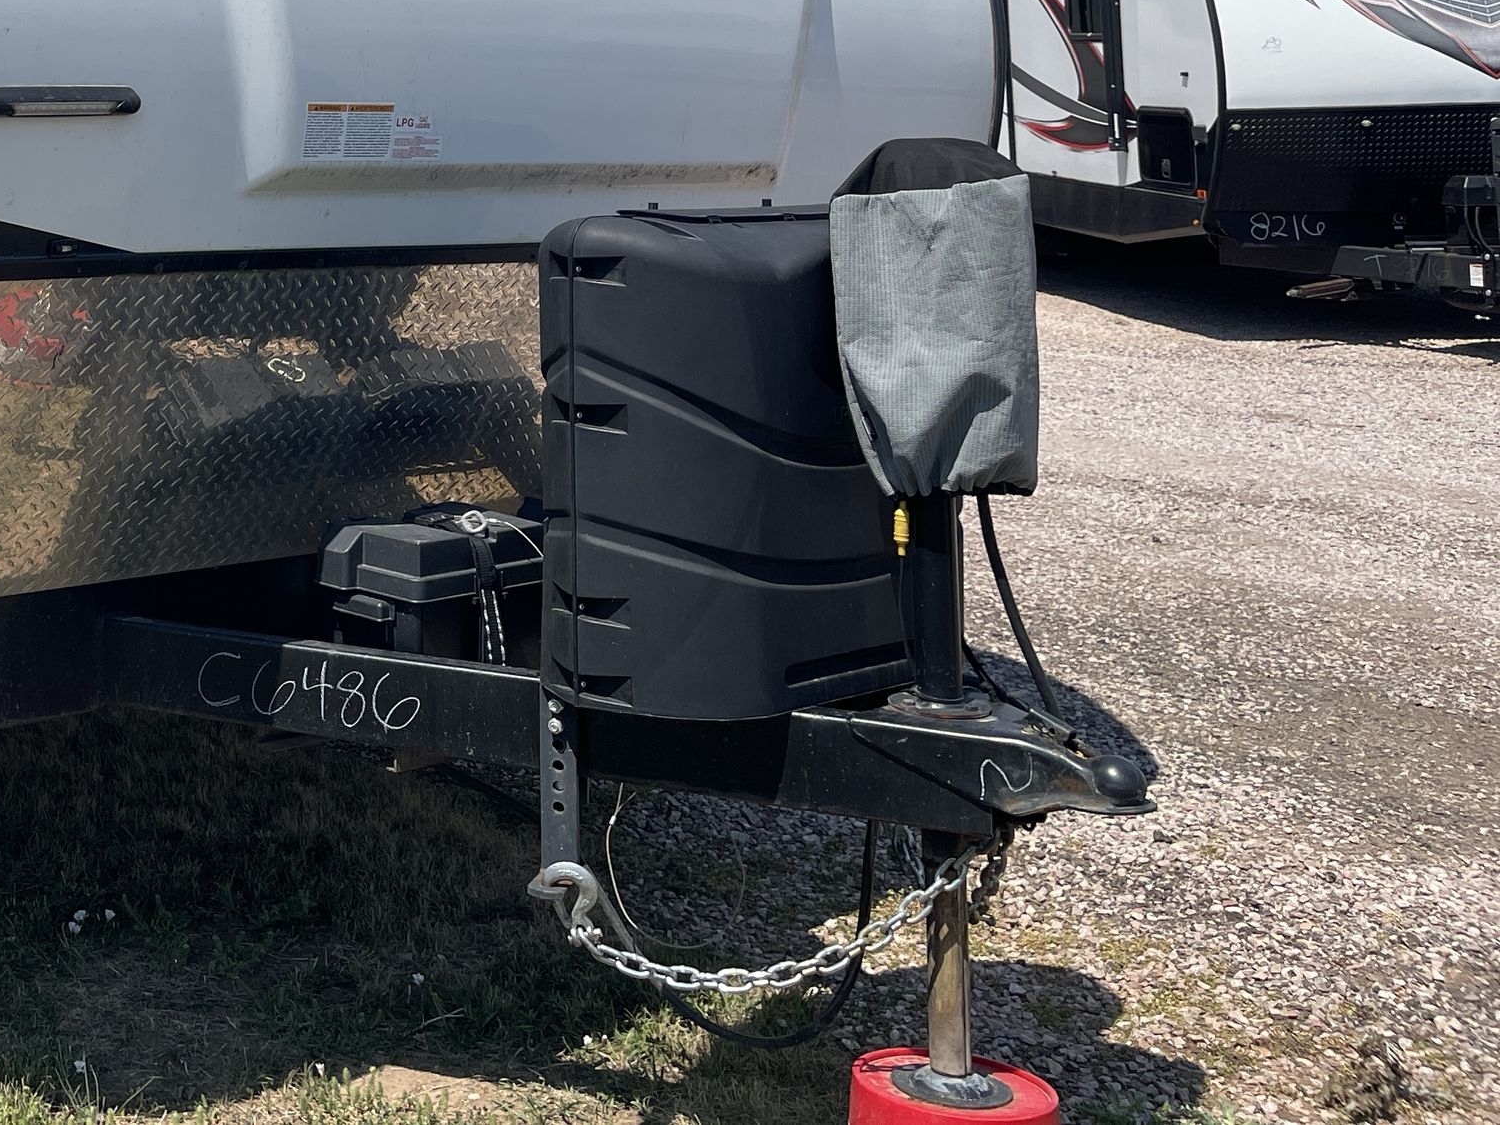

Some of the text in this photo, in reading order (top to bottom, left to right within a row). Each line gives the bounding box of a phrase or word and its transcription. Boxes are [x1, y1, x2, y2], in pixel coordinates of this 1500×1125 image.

[396, 117, 415, 128] LPG
[1249, 212, 1326, 241] 8216
[197, 651, 422, 734] C6486
